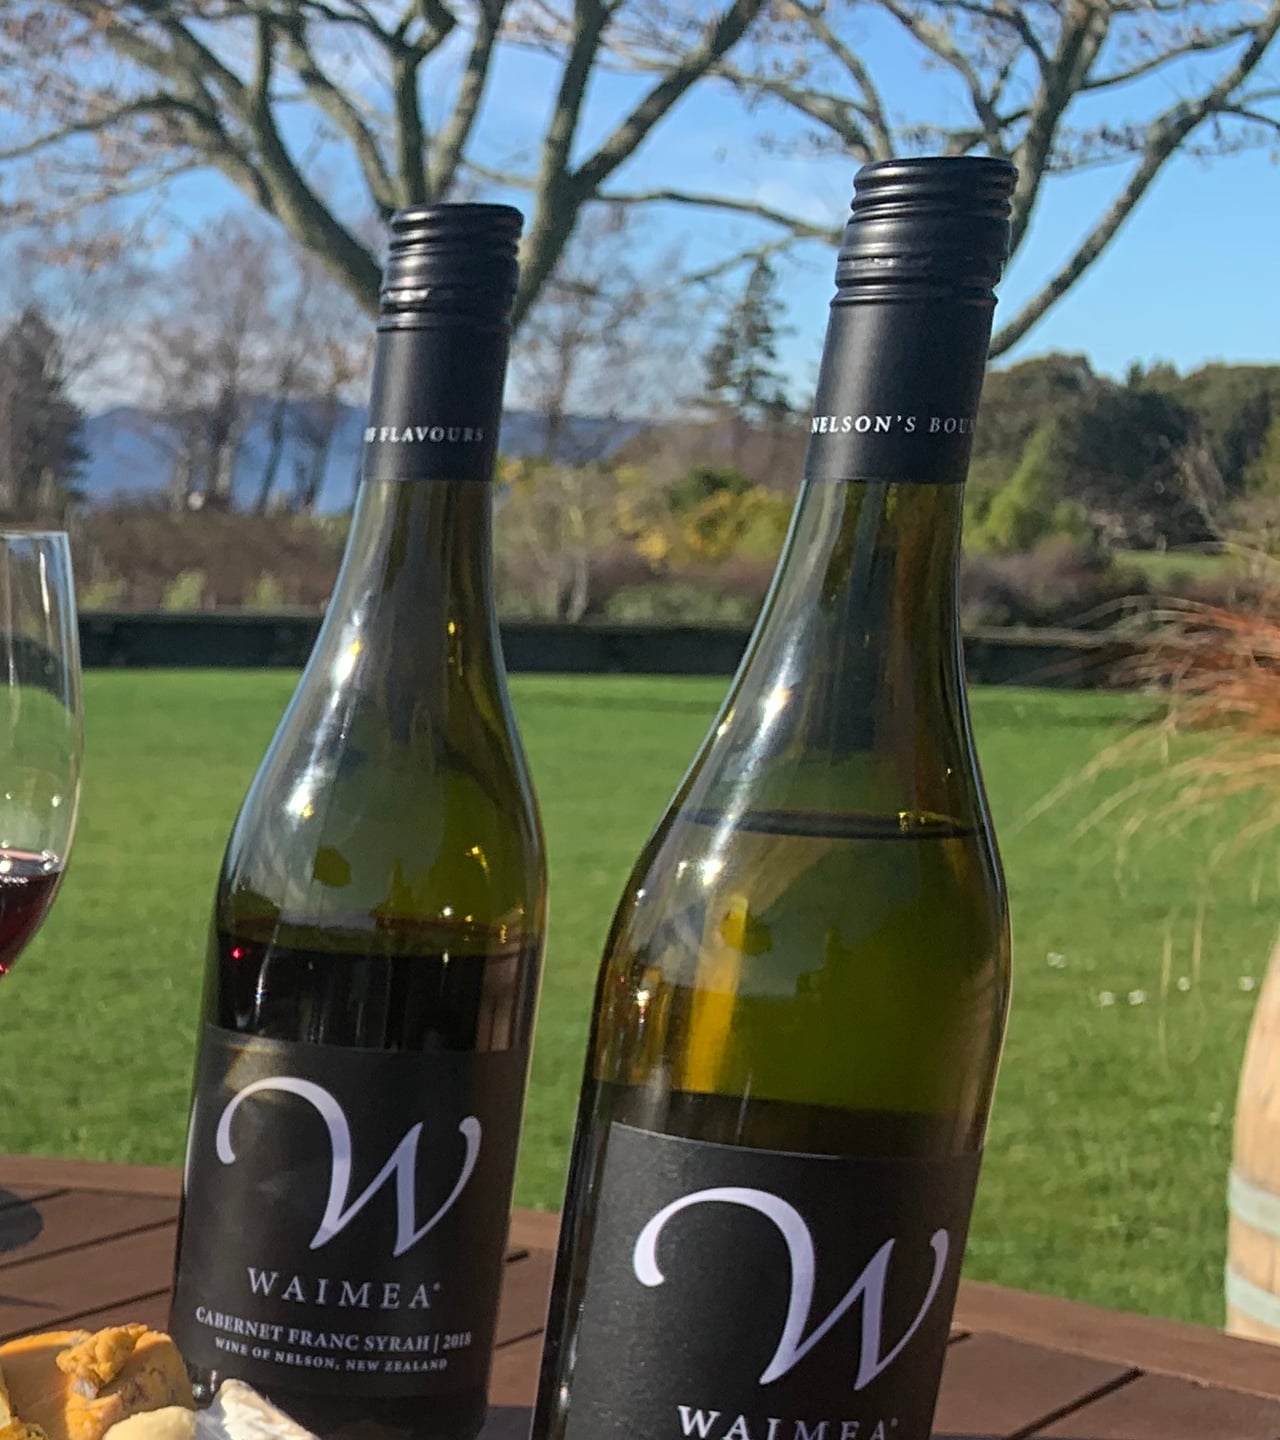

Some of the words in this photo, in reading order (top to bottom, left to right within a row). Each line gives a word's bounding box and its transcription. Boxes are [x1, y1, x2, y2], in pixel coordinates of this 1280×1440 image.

[380, 427, 483, 442] FLAVOURS
[811, 415, 916, 434] NELSON'S
[248, 1267, 430, 1310] WAIMEA
[196, 1306, 283, 1342] CABERNET
[288, 1328, 358, 1349] FRANC
[364, 1336, 430, 1352] SYRAH
[443, 1332, 472, 1348] 2018
[215, 1336, 248, 1355] WINE
[252, 1347, 270, 1360] OF
[275, 1351, 340, 1370] NELSON,
[346, 1359, 380, 1371] NEW
[385, 1358, 448, 1372] ZEALAND
